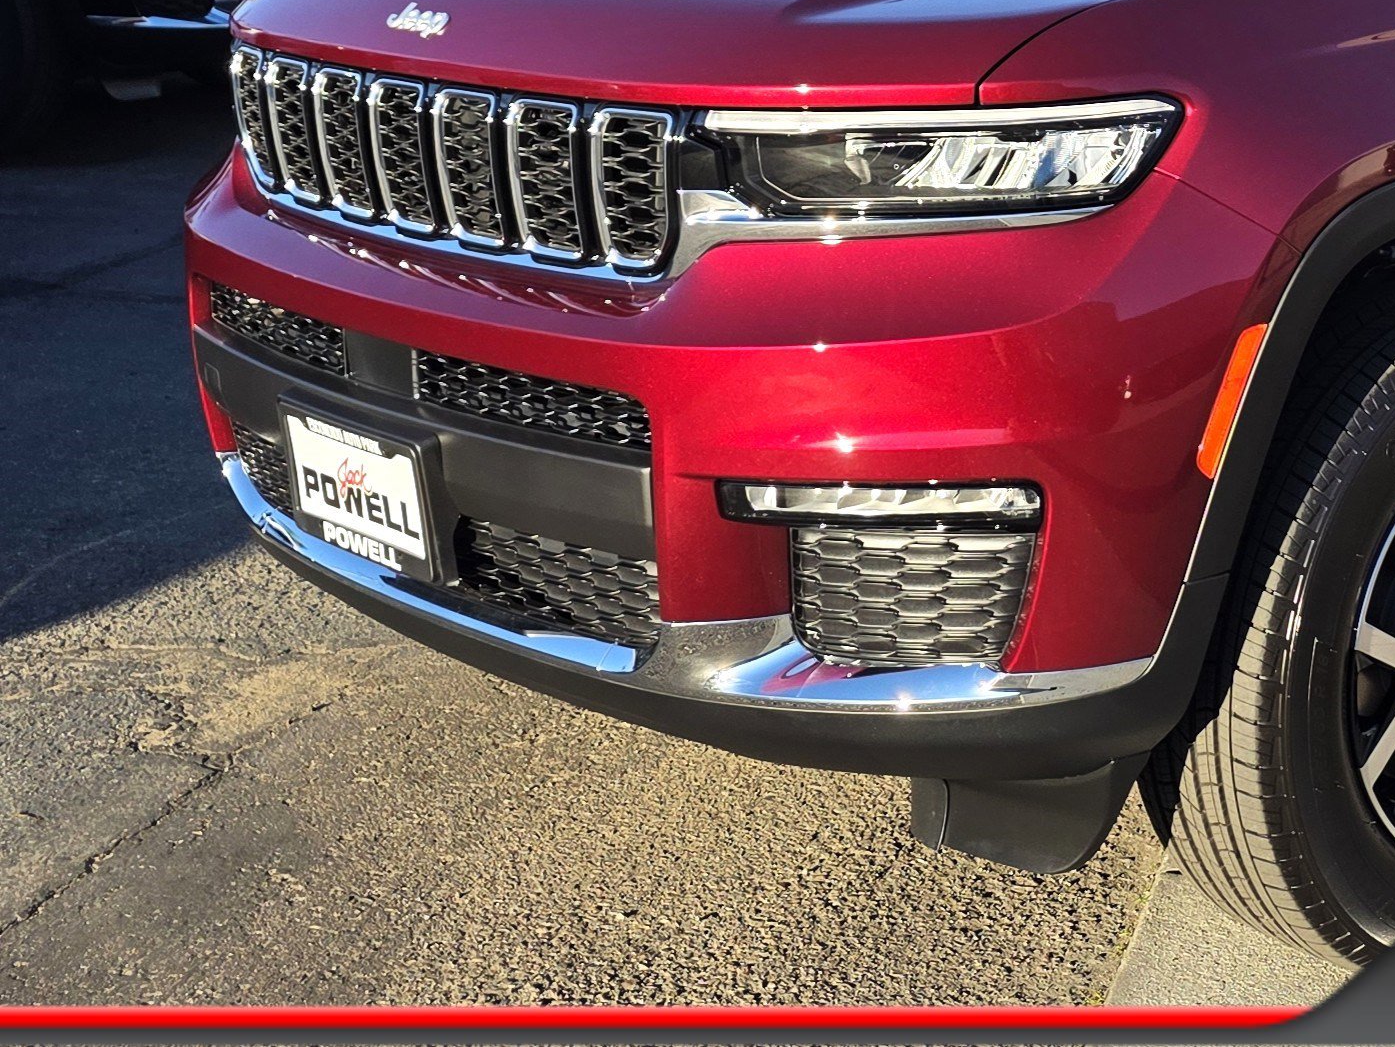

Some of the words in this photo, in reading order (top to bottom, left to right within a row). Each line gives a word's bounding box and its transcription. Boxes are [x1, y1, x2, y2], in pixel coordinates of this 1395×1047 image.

[386, 1, 450, 40] Jeep
[337, 457, 373, 500] Jack
[302, 465, 421, 540] POWELL
[322, 520, 402, 572] POWELL
